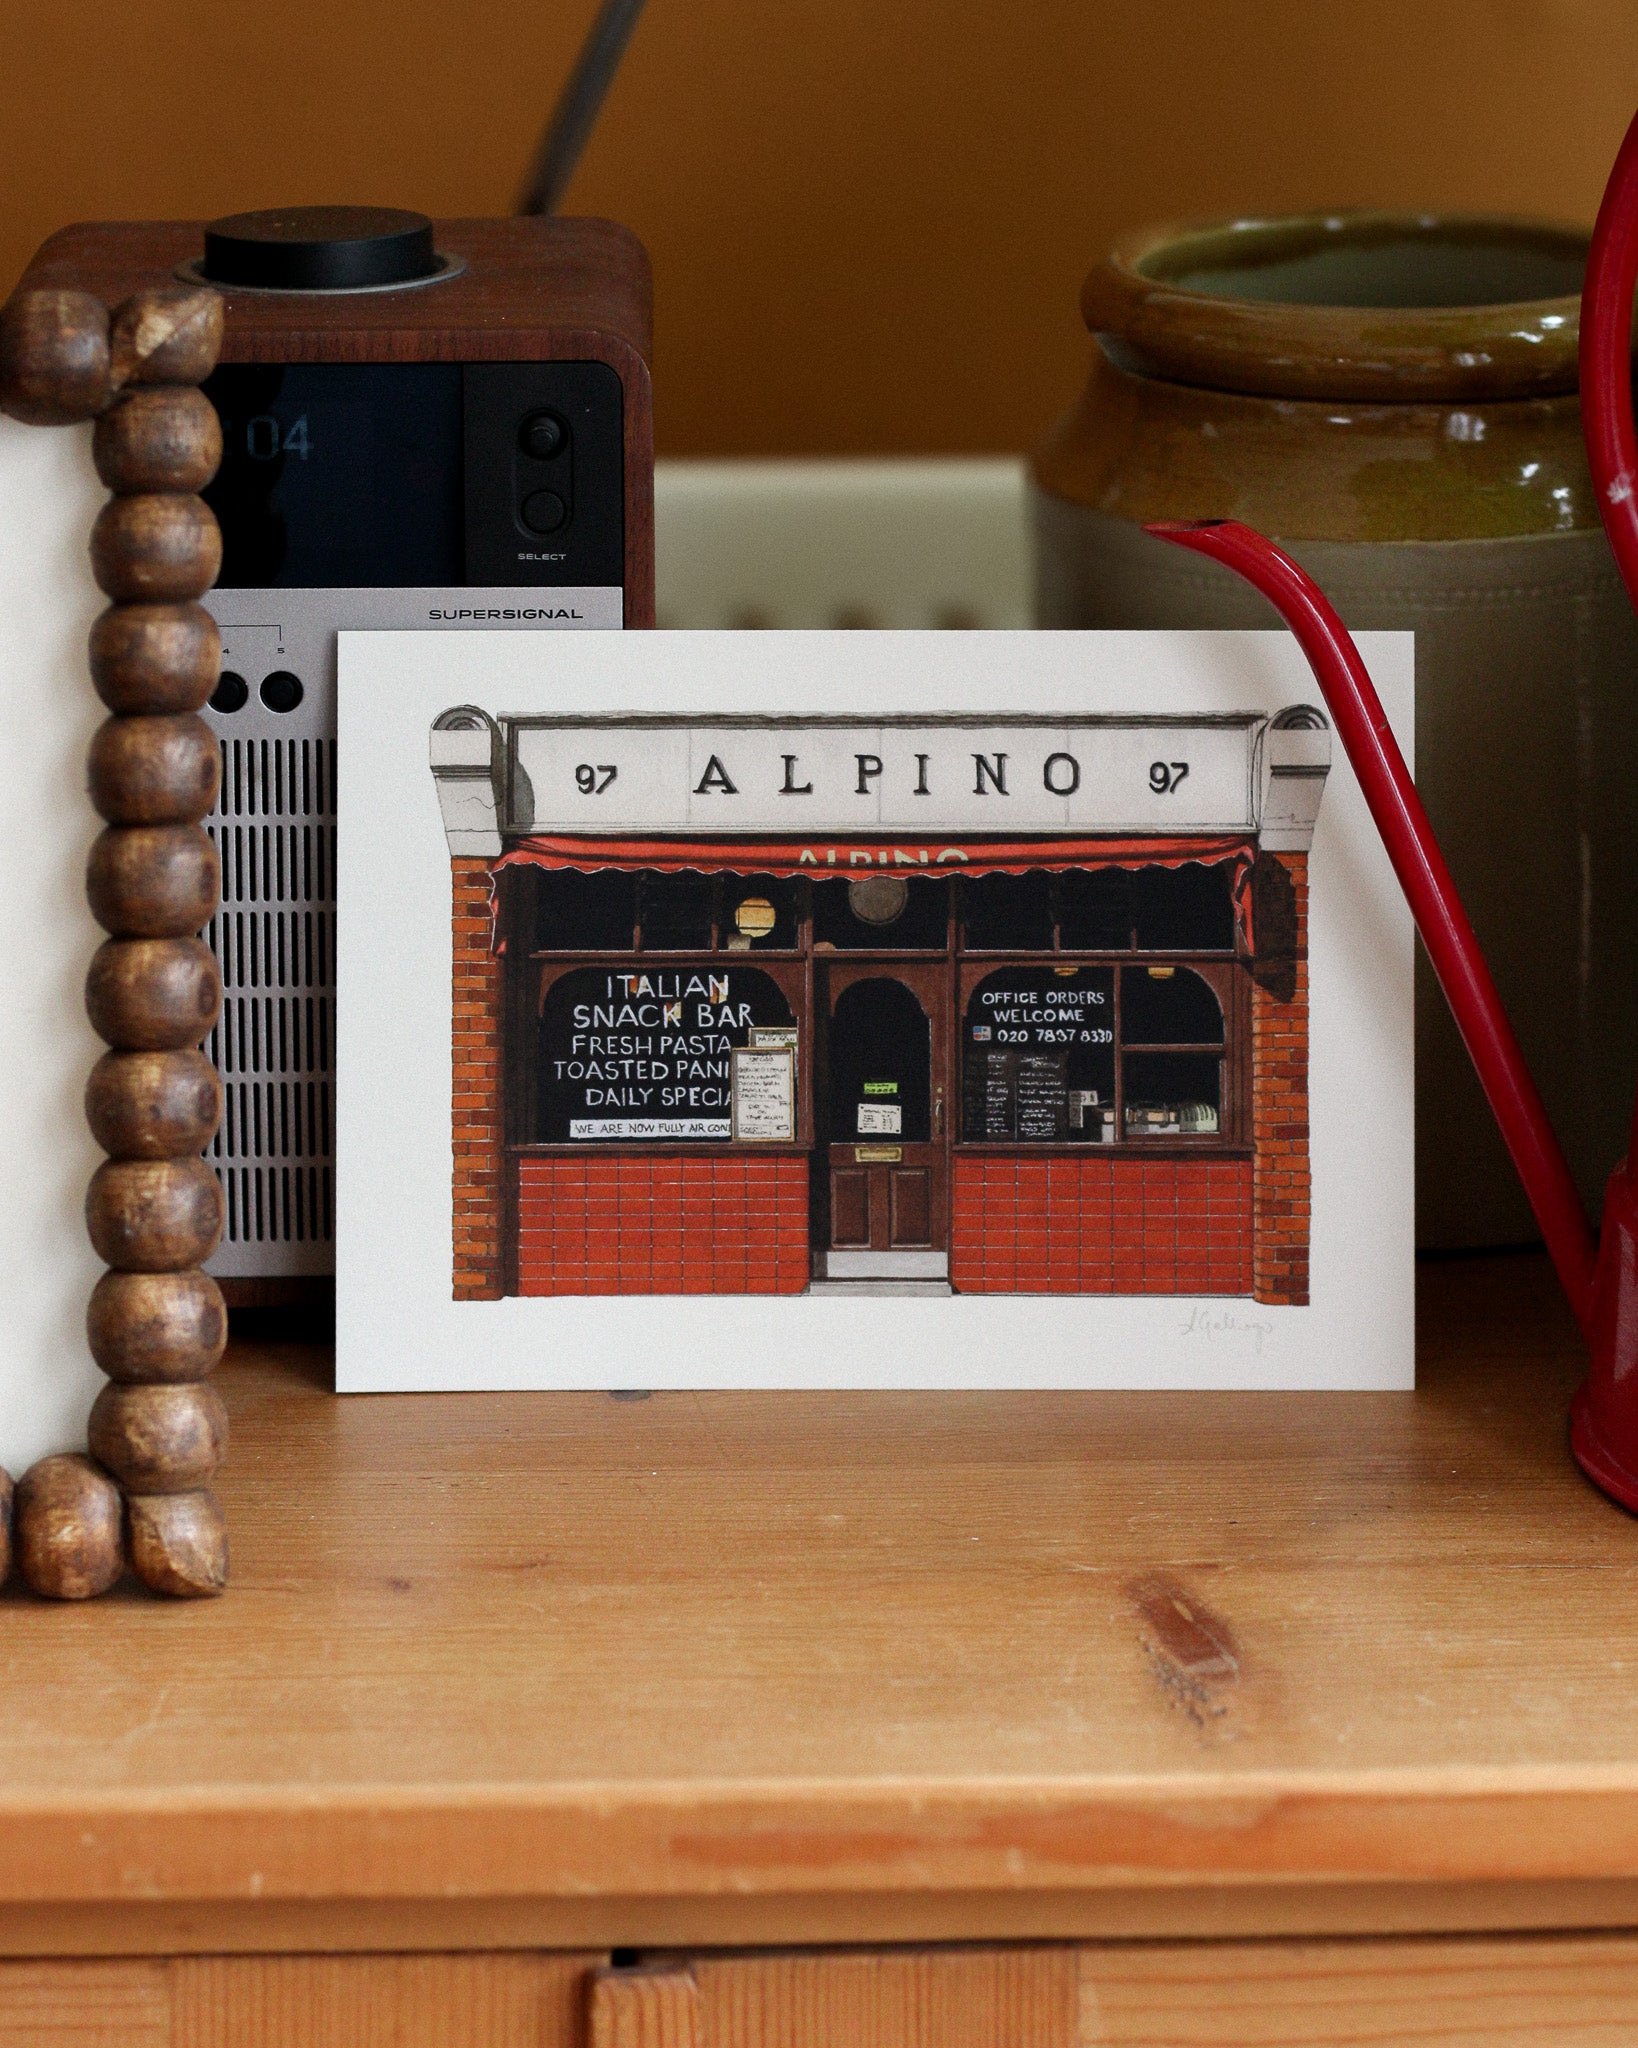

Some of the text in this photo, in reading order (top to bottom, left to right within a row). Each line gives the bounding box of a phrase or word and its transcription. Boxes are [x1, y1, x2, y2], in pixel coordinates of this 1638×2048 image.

[517, 553, 567, 561] SELECT
[428, 608, 584, 620] SUPERSIGNAL
[277, 647, 285, 655] 5
[575, 752, 1190, 796] 97 ALPINO 97
[607, 974, 729, 998] ITALIAN
[981, 991, 1105, 1004] OFFICE ORDERS
[573, 1002, 754, 1029] SNACK BAR
[993, 1008, 1085, 1023] WELCOME
[997, 1029, 1029, 1042] 020
[572, 1034, 732, 1055] FRESH PASTA
[553, 1060, 669, 1080] TOASTED
[586, 1087, 653, 1107] DAILY
[575, 1123, 594, 1134] WE
[600, 1123, 623, 1134] ARE
[628, 1123, 655, 1134] NOW
[658, 1122, 685, 1133] FULLY
[688, 1123, 705, 1133] AIR
